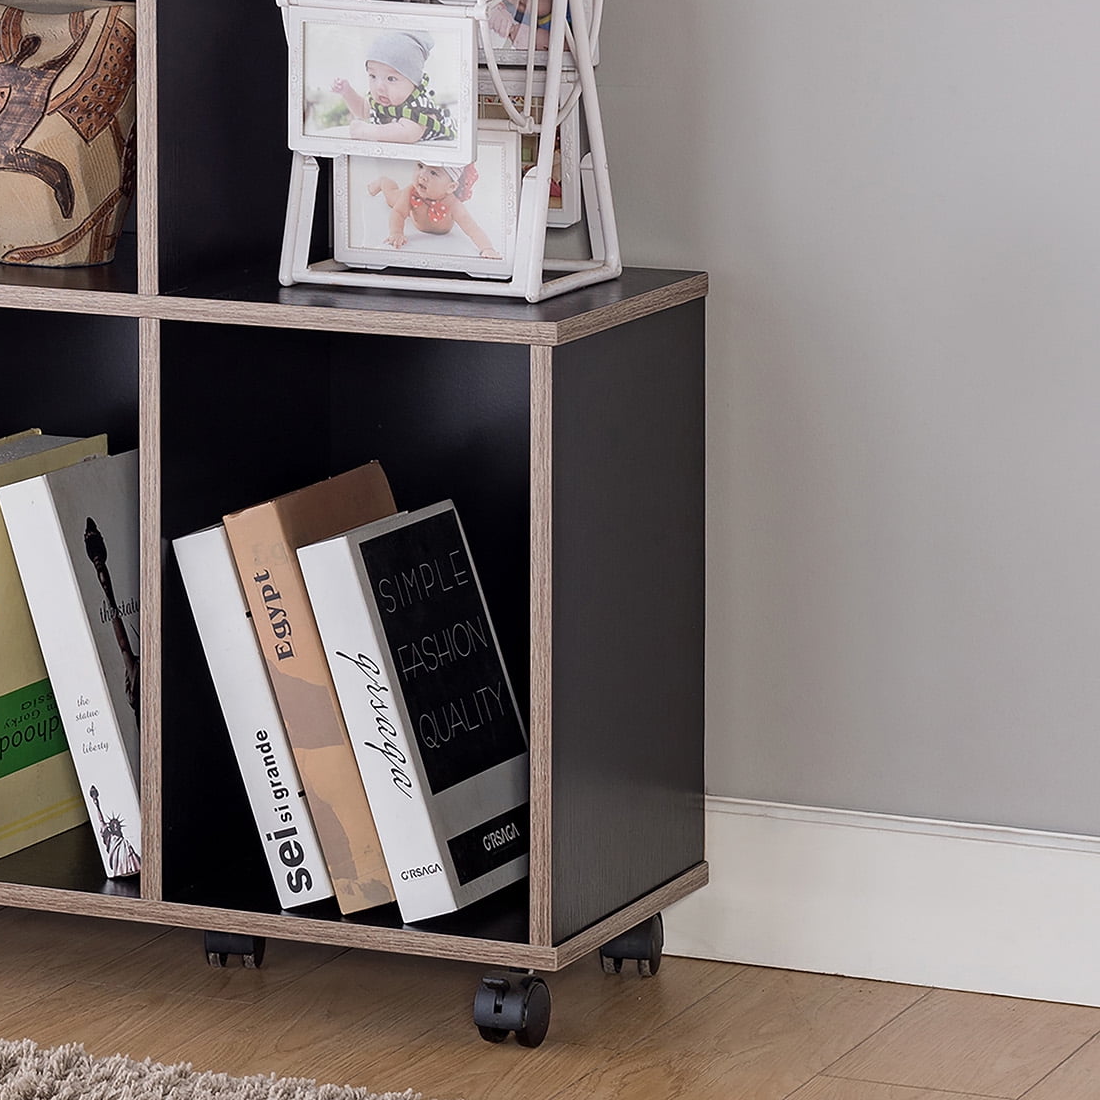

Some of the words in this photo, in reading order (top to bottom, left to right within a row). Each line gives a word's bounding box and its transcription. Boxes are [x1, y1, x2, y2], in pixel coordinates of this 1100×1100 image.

[378, 550, 469, 613] SIMPLE
[253, 568, 295, 661] Egypt
[397, 616, 488, 682] FASHION
[21, 693, 54, 710] ssia
[75, 709, 99, 721] statue
[76, 695, 89, 707] the
[419, 681, 505, 749] QUALITY
[3, 709, 40, 729] Gorky
[86, 721, 95, 736] of
[0, 715, 60, 760] dhood
[82, 741, 109, 754] liberty
[255, 729, 289, 800] grande
[274, 804, 293, 823] si
[265, 826, 313, 894] sei
